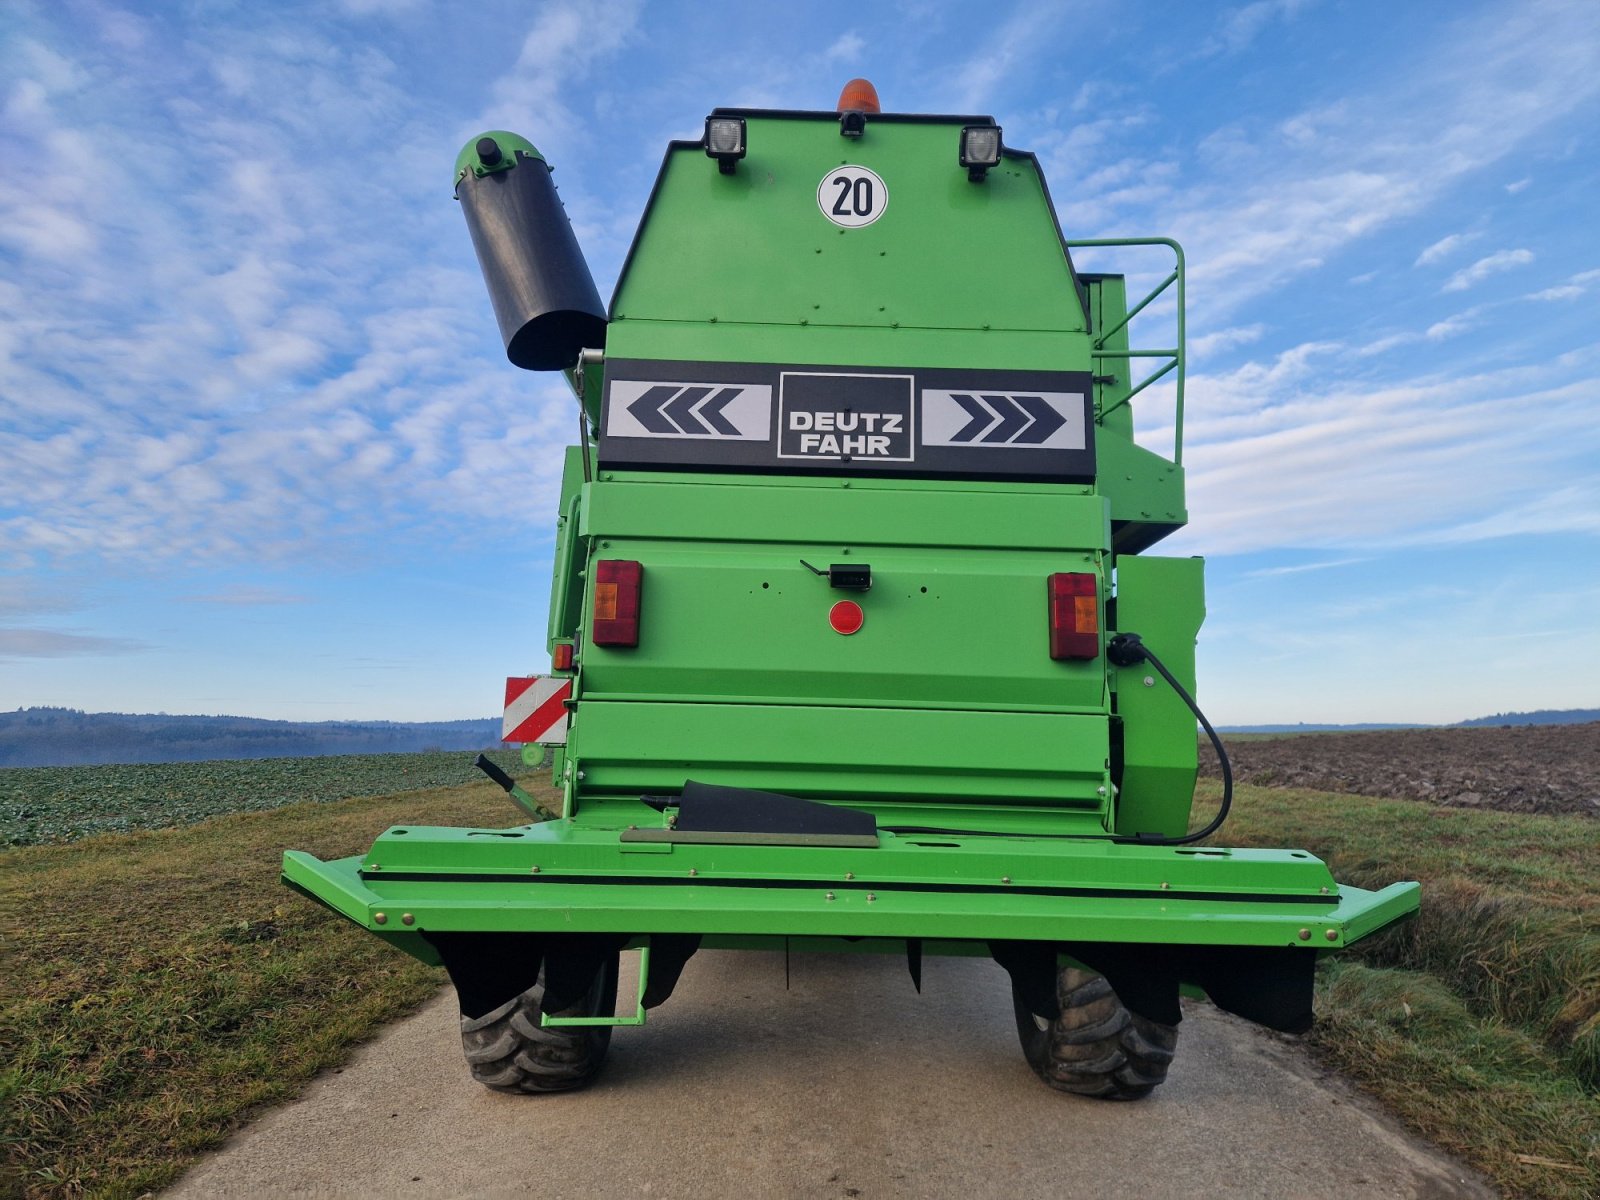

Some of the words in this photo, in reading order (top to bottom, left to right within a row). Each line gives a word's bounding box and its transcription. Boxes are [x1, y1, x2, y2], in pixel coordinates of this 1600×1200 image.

[832, 176, 873, 216] 20
[789, 411, 903, 433] DEUTZ
[800, 433, 891, 455] FAHR
